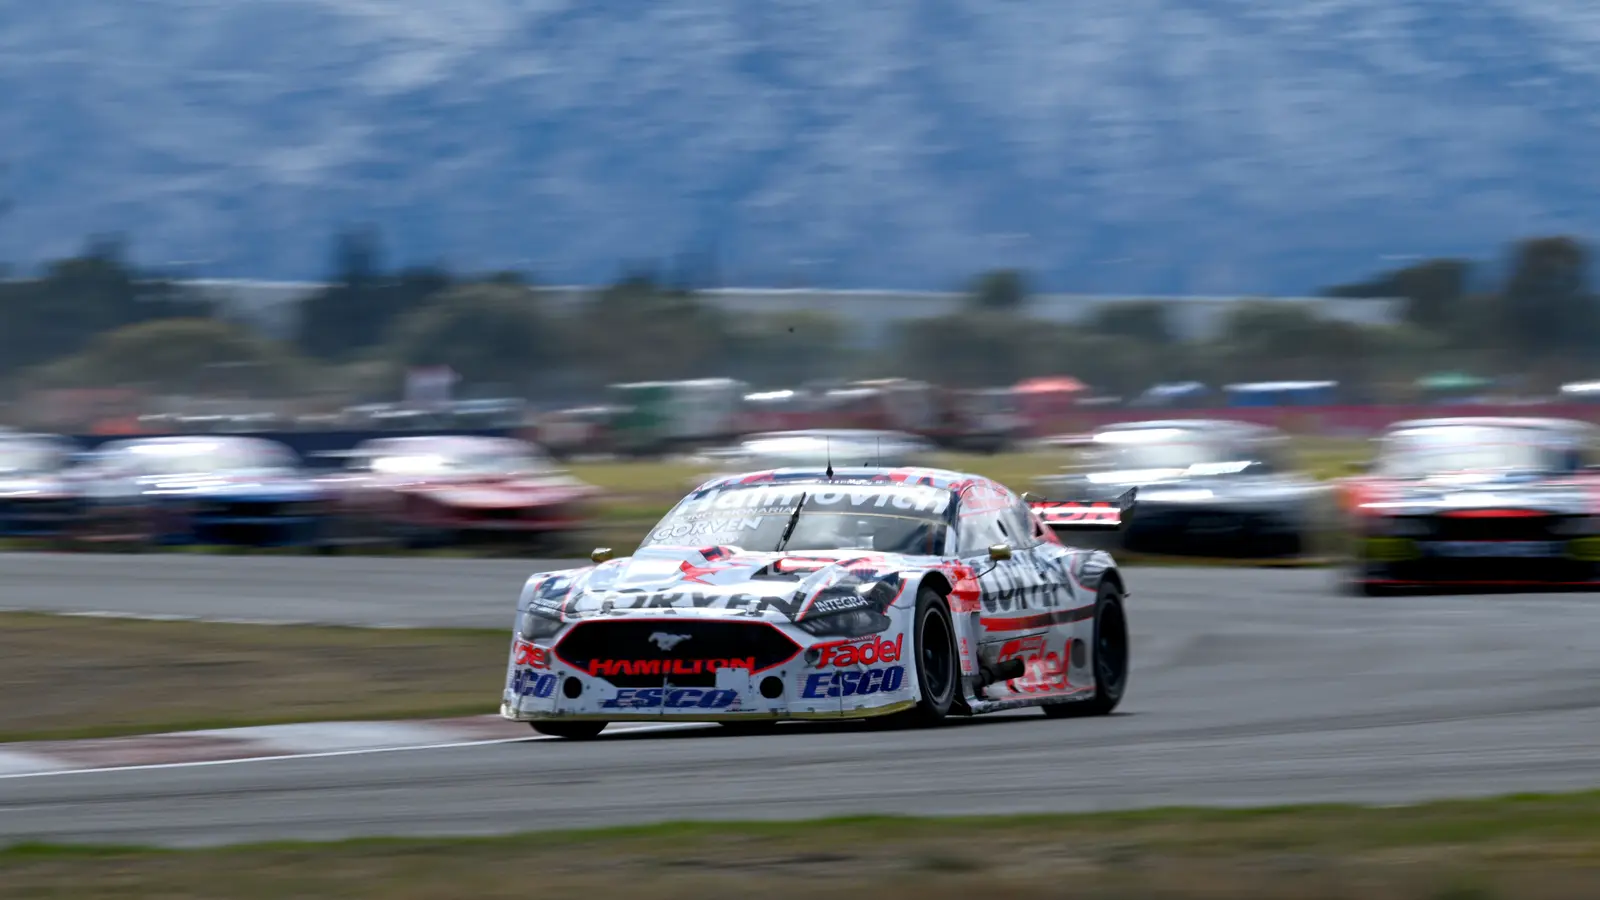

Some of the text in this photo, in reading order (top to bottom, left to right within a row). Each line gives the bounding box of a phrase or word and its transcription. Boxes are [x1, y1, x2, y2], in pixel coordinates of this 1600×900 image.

[674, 485, 951, 516] Haimovich
[652, 516, 763, 541] CORVEN
[815, 596, 869, 612] INTEGRA
[811, 633, 904, 669] Fadel
[588, 656, 756, 676] HAMILTON
[802, 665, 904, 698] ESCO
[602, 688, 738, 708] ESCO
